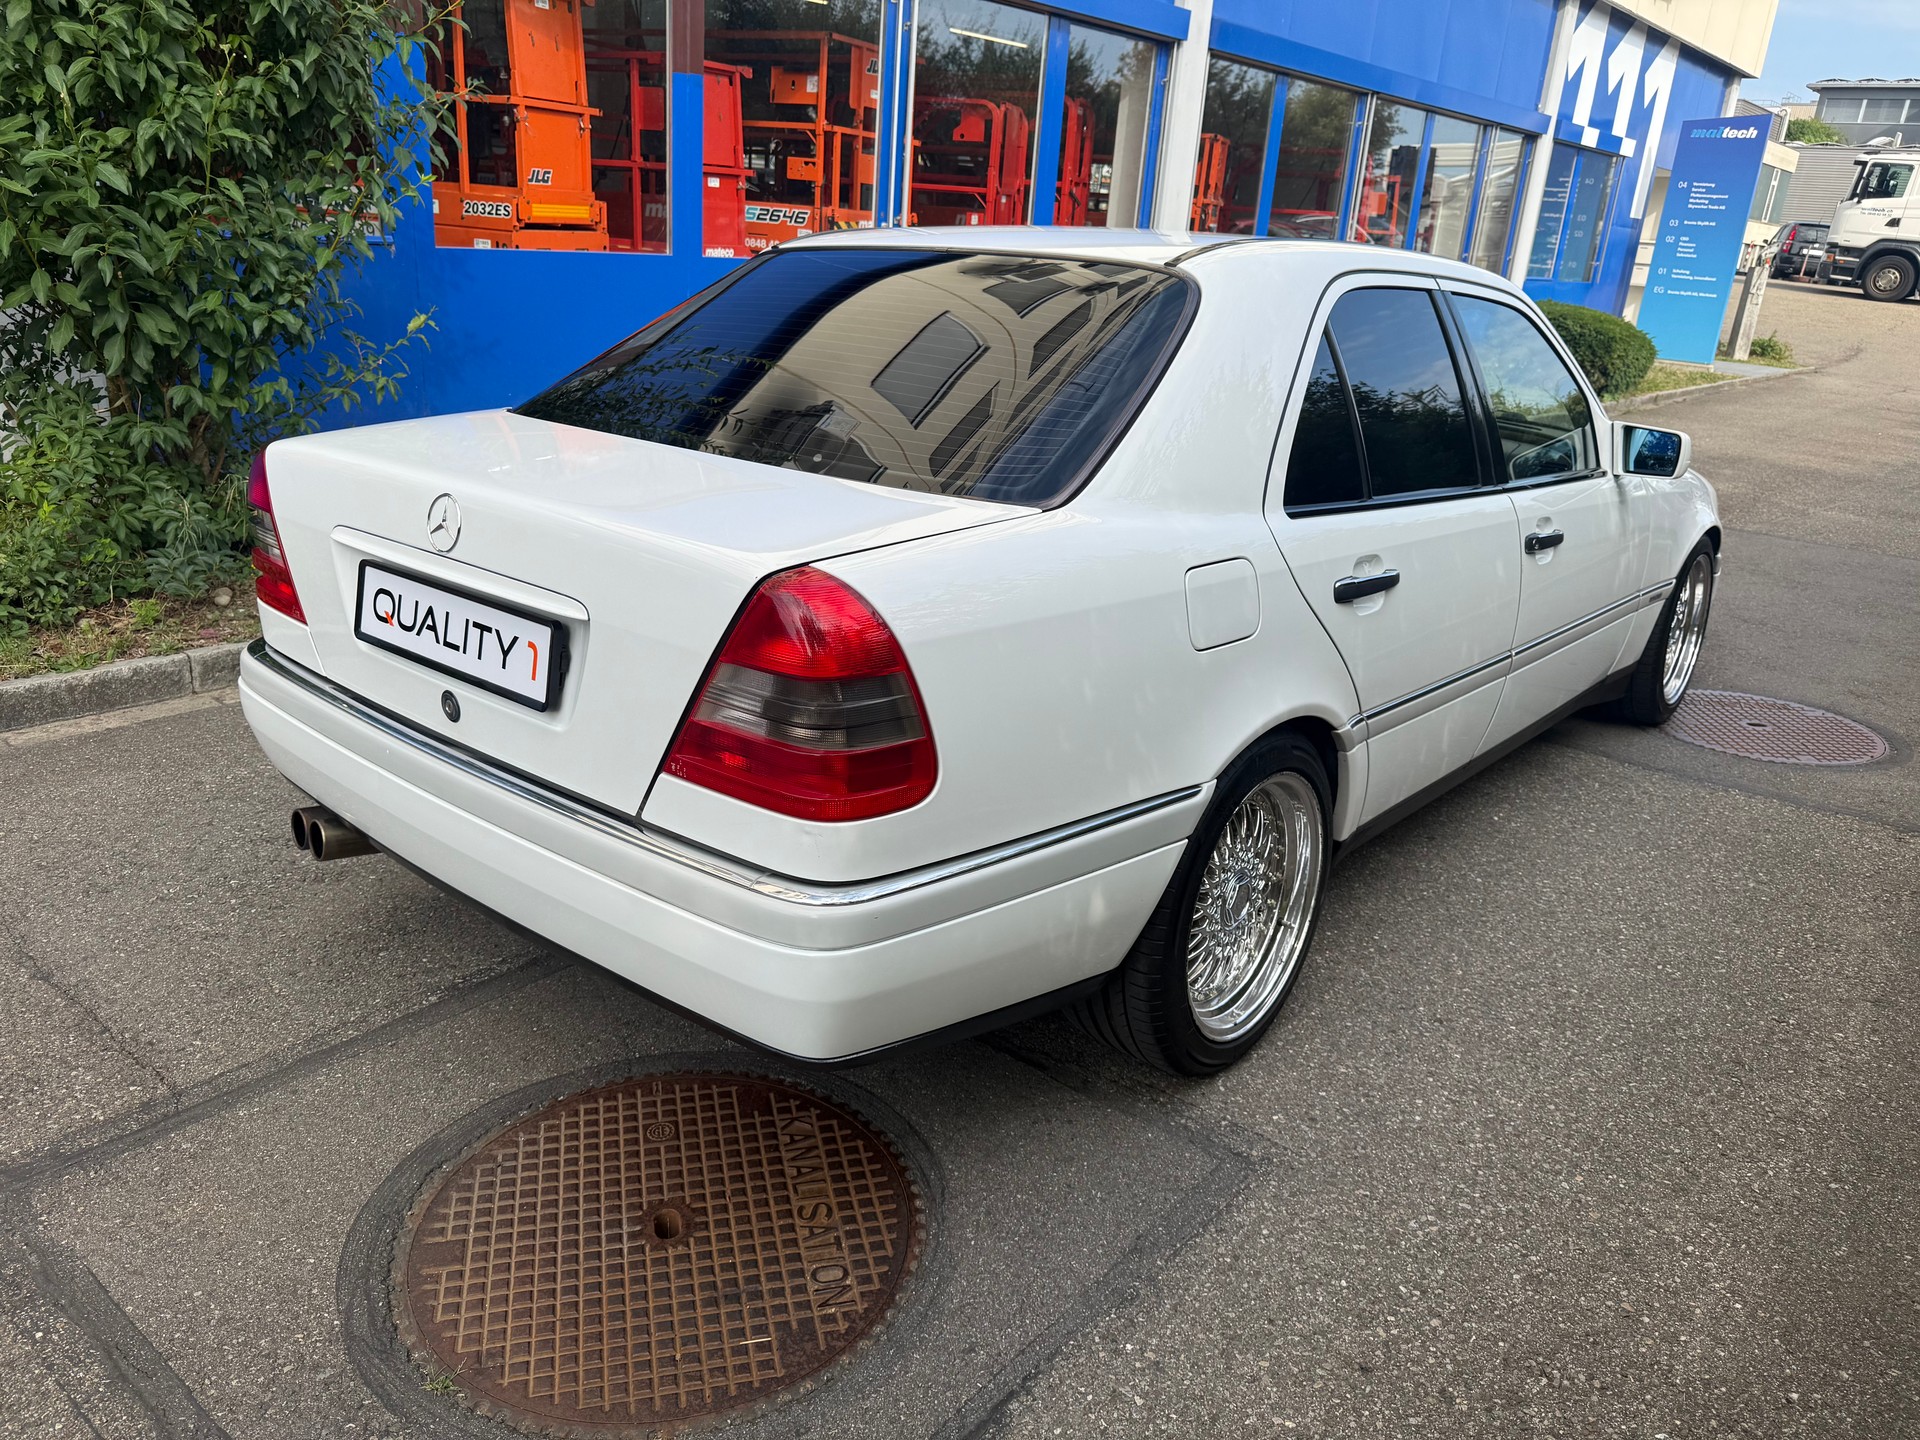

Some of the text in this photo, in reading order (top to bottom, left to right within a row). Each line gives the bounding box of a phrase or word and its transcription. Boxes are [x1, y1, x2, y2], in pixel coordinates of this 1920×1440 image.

[866, 58, 879, 74] JL
[1690, 127, 1758, 139] maltech
[528, 168, 552, 185] JLG
[1678, 181, 1688, 189] 04
[464, 201, 511, 217] 2032ES
[1669, 219, 1679, 227] 03
[744, 237, 767, 249] 0848
[1665, 235, 1676, 243] 02
[705, 246, 735, 258] mateco
[1657, 267, 1667, 275] 01
[1653, 285, 1664, 294] EG
[779, 1114, 858, 1313] KANALISATION
